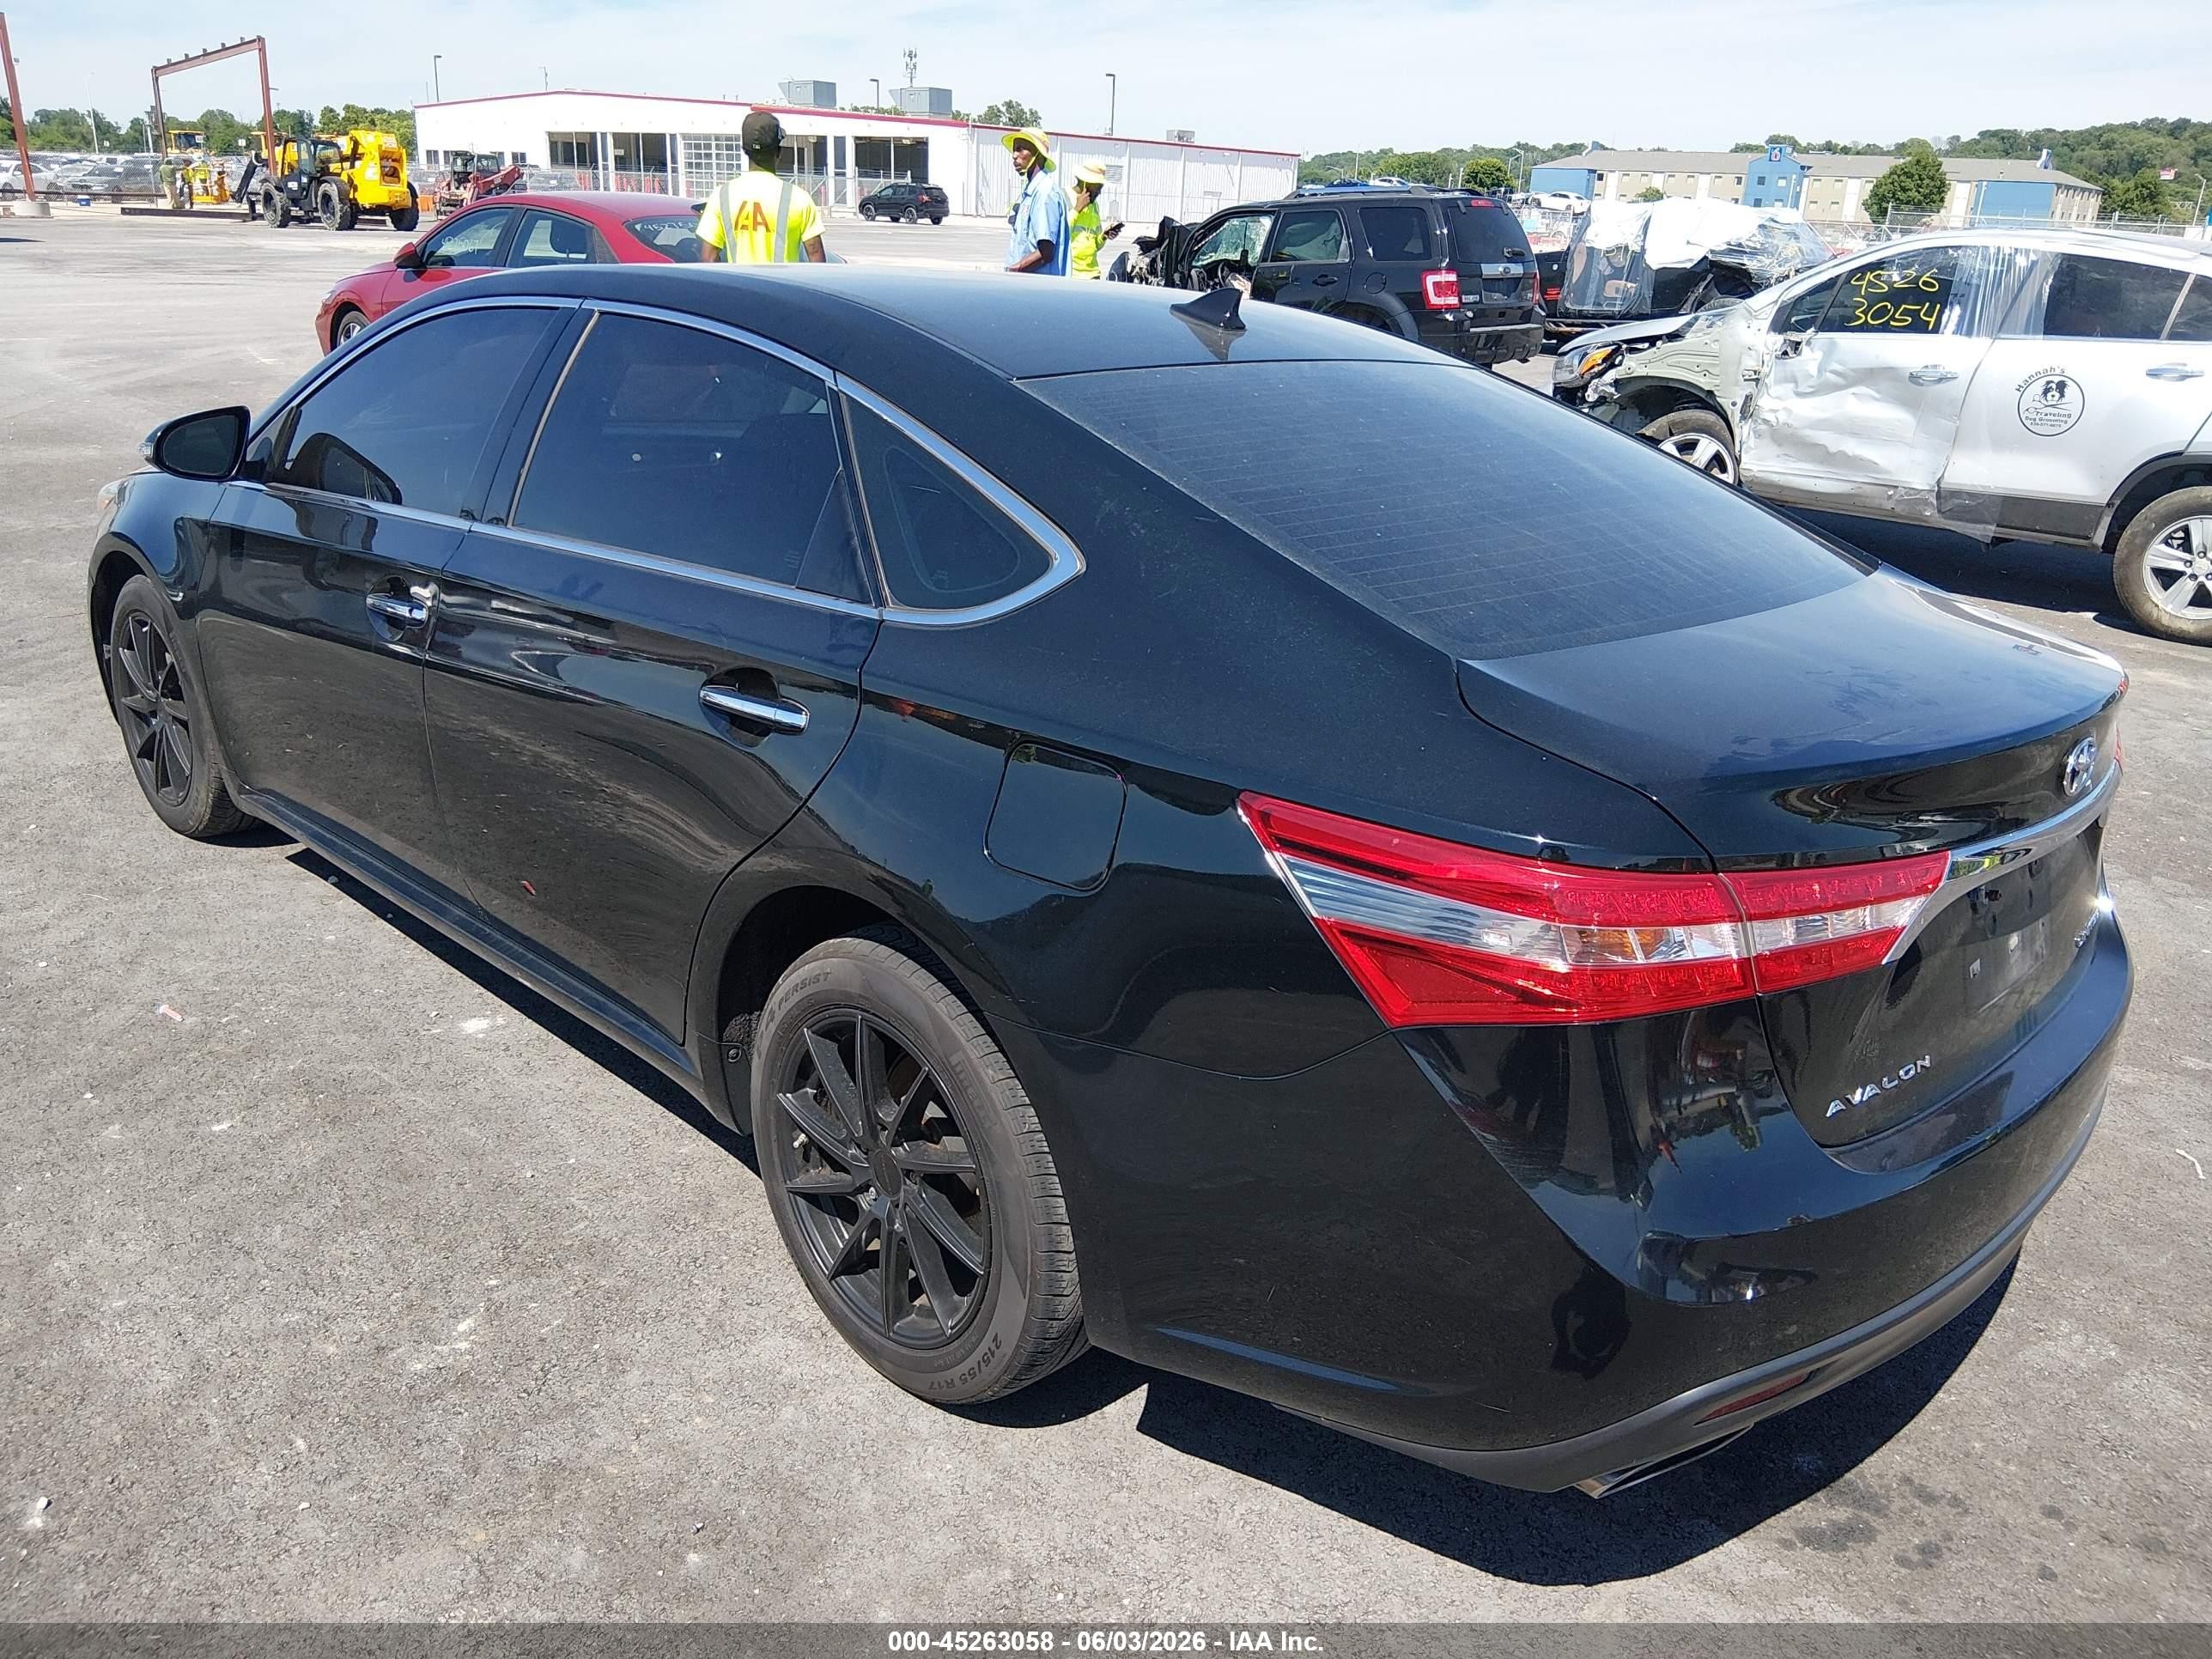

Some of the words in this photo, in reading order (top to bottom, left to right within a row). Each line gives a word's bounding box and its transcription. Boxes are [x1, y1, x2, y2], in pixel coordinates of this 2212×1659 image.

[1850, 268, 1939, 295] 4526
[1844, 297, 1941, 331] 3054
[2014, 366, 2066, 392] Hannah's
[2038, 416, 2069, 425] Grooming
[778, 970, 831, 1011] PERSIST
[1826, 1054, 1931, 1118] AVALON
[958, 1332, 1003, 1385] 215/55
[928, 1378, 956, 1390] R17
